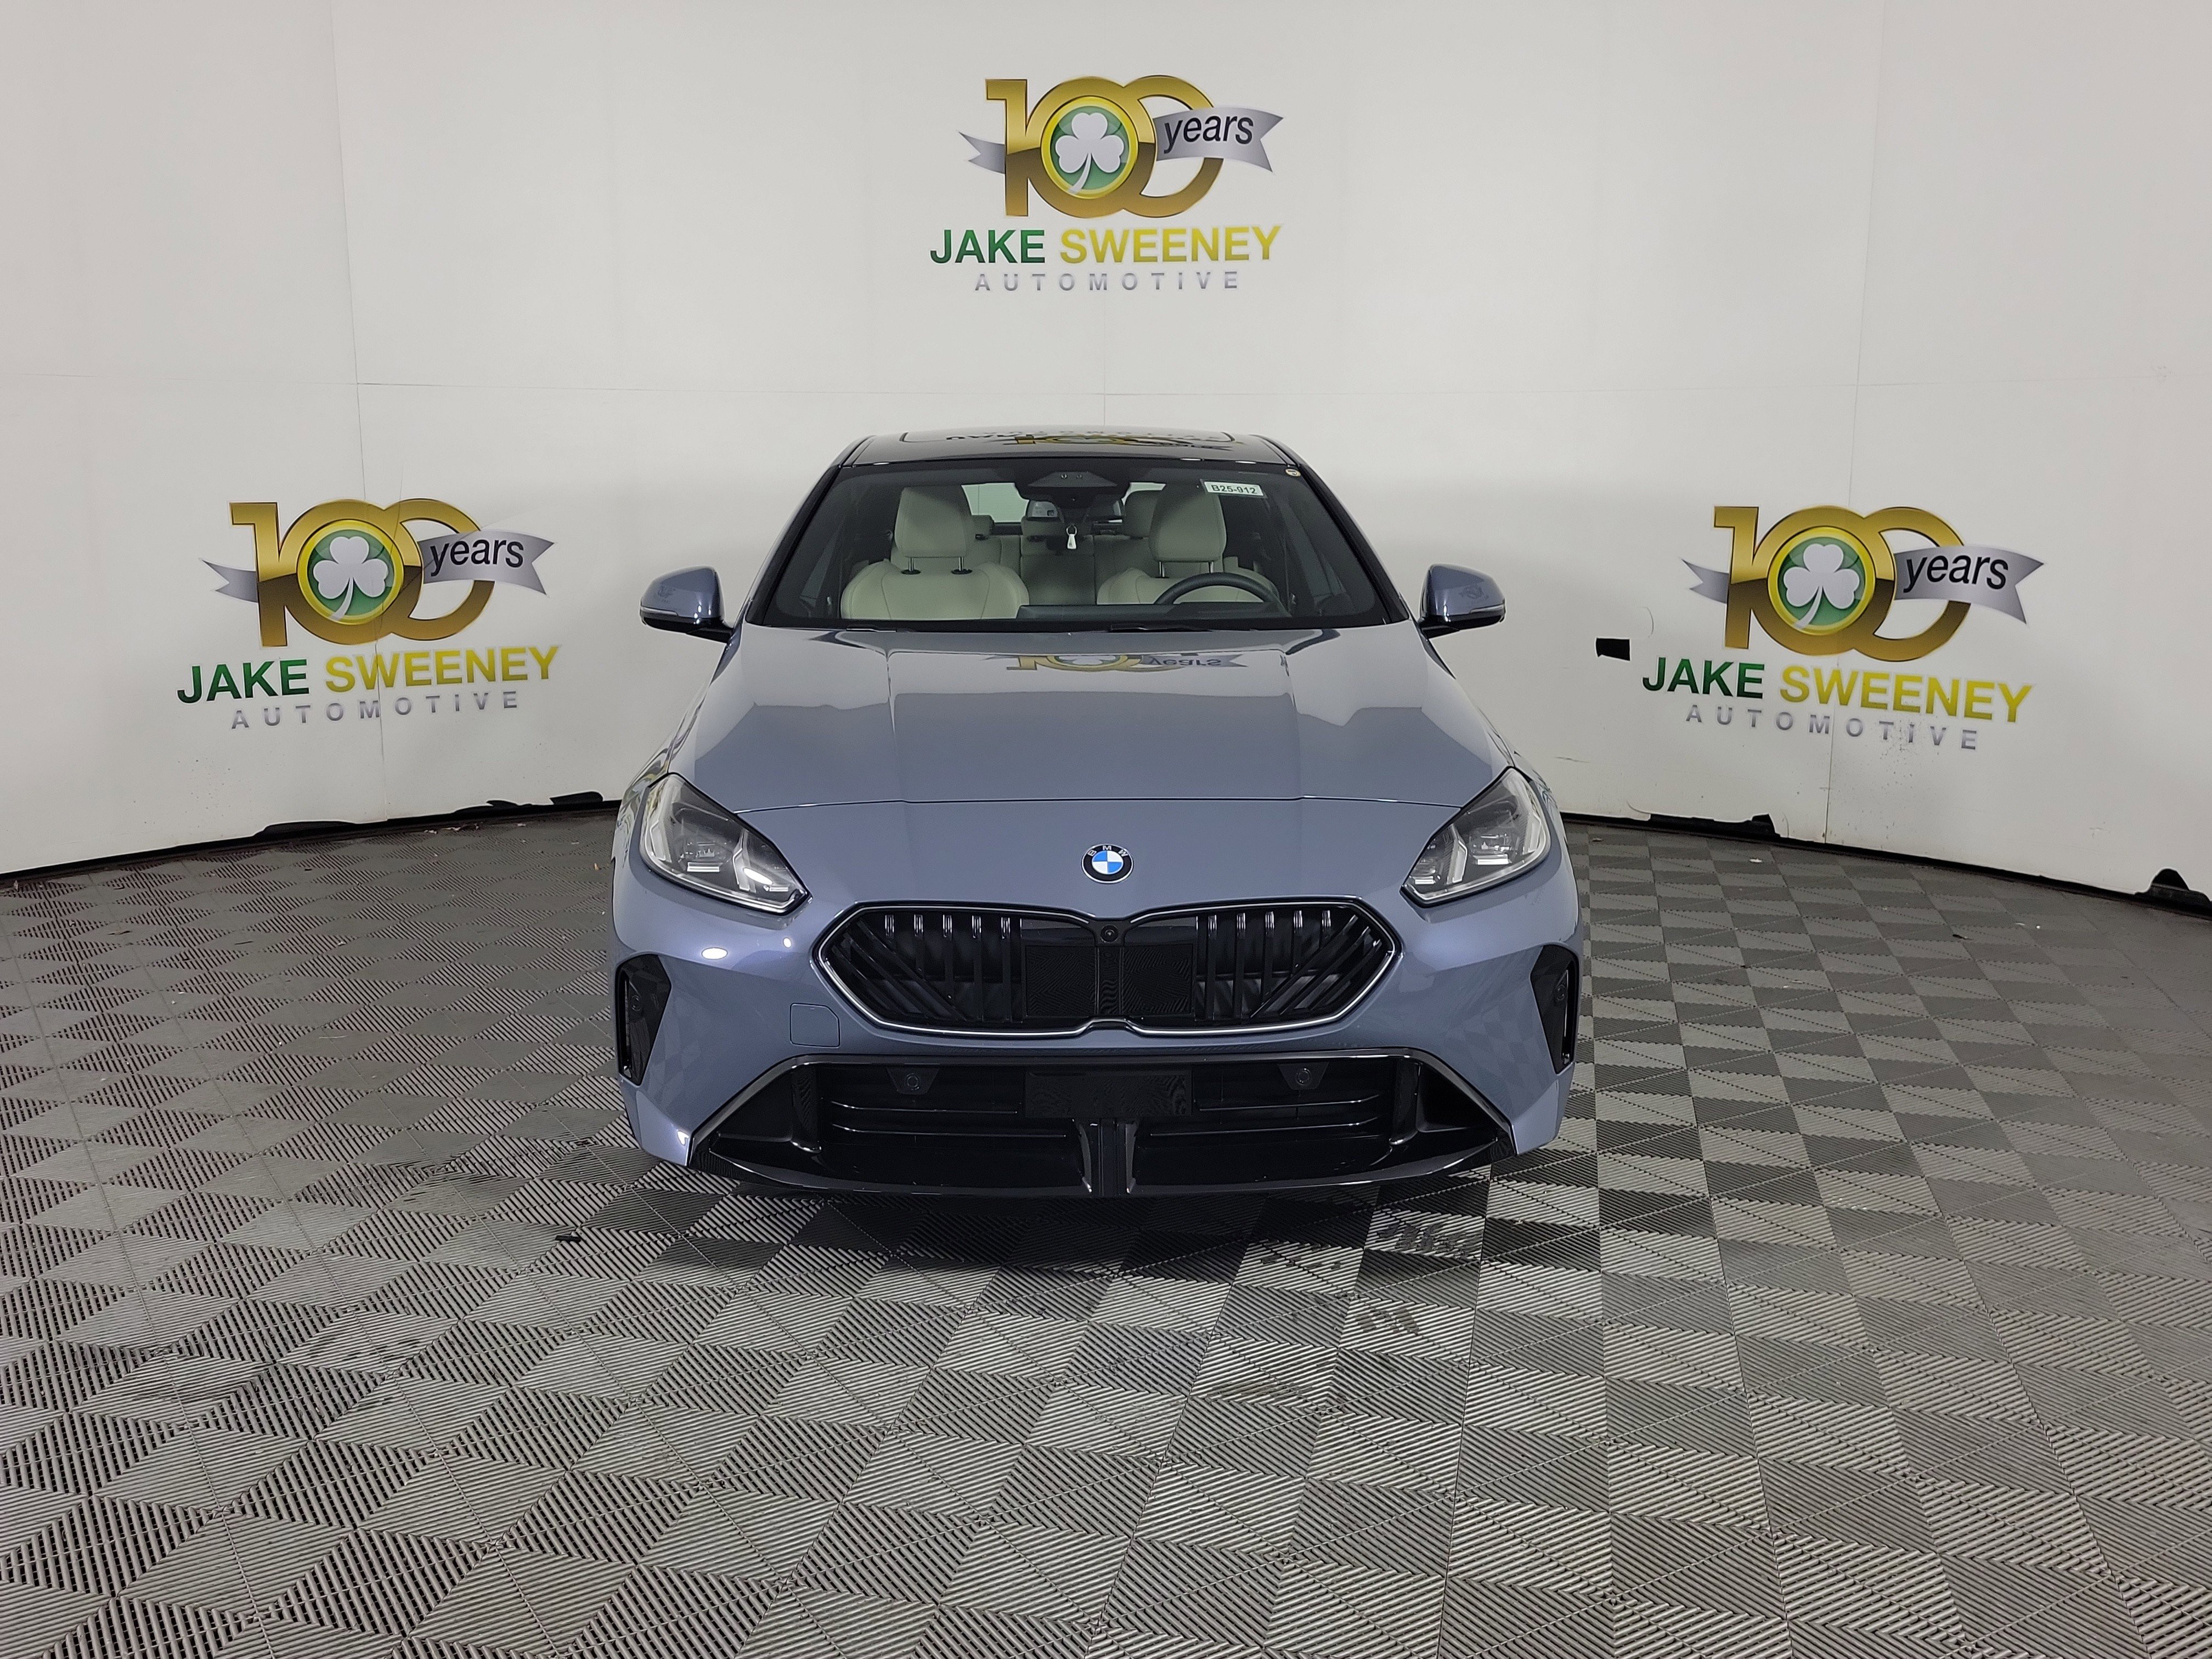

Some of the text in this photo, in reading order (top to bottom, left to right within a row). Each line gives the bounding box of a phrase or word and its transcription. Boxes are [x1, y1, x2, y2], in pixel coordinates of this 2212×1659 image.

[985, 75, 1254, 218] 100 years
[930, 225, 1281, 263] JAKE SWEENEY
[975, 272, 1238, 291] AUTOMOTIVE
[1211, 484, 1257, 494] B25-912
[229, 498, 524, 647] 100 years
[1714, 505, 2008, 662] 100 years
[177, 646, 559, 703] JAKE SWEENEY
[1643, 657, 2033, 723] JAKE SWEENEY
[231, 691, 517, 729] AUTOMOTIVE
[1686, 704, 1977, 750] AUTOMOTIVE
[1087, 845, 1128, 856] BMW
